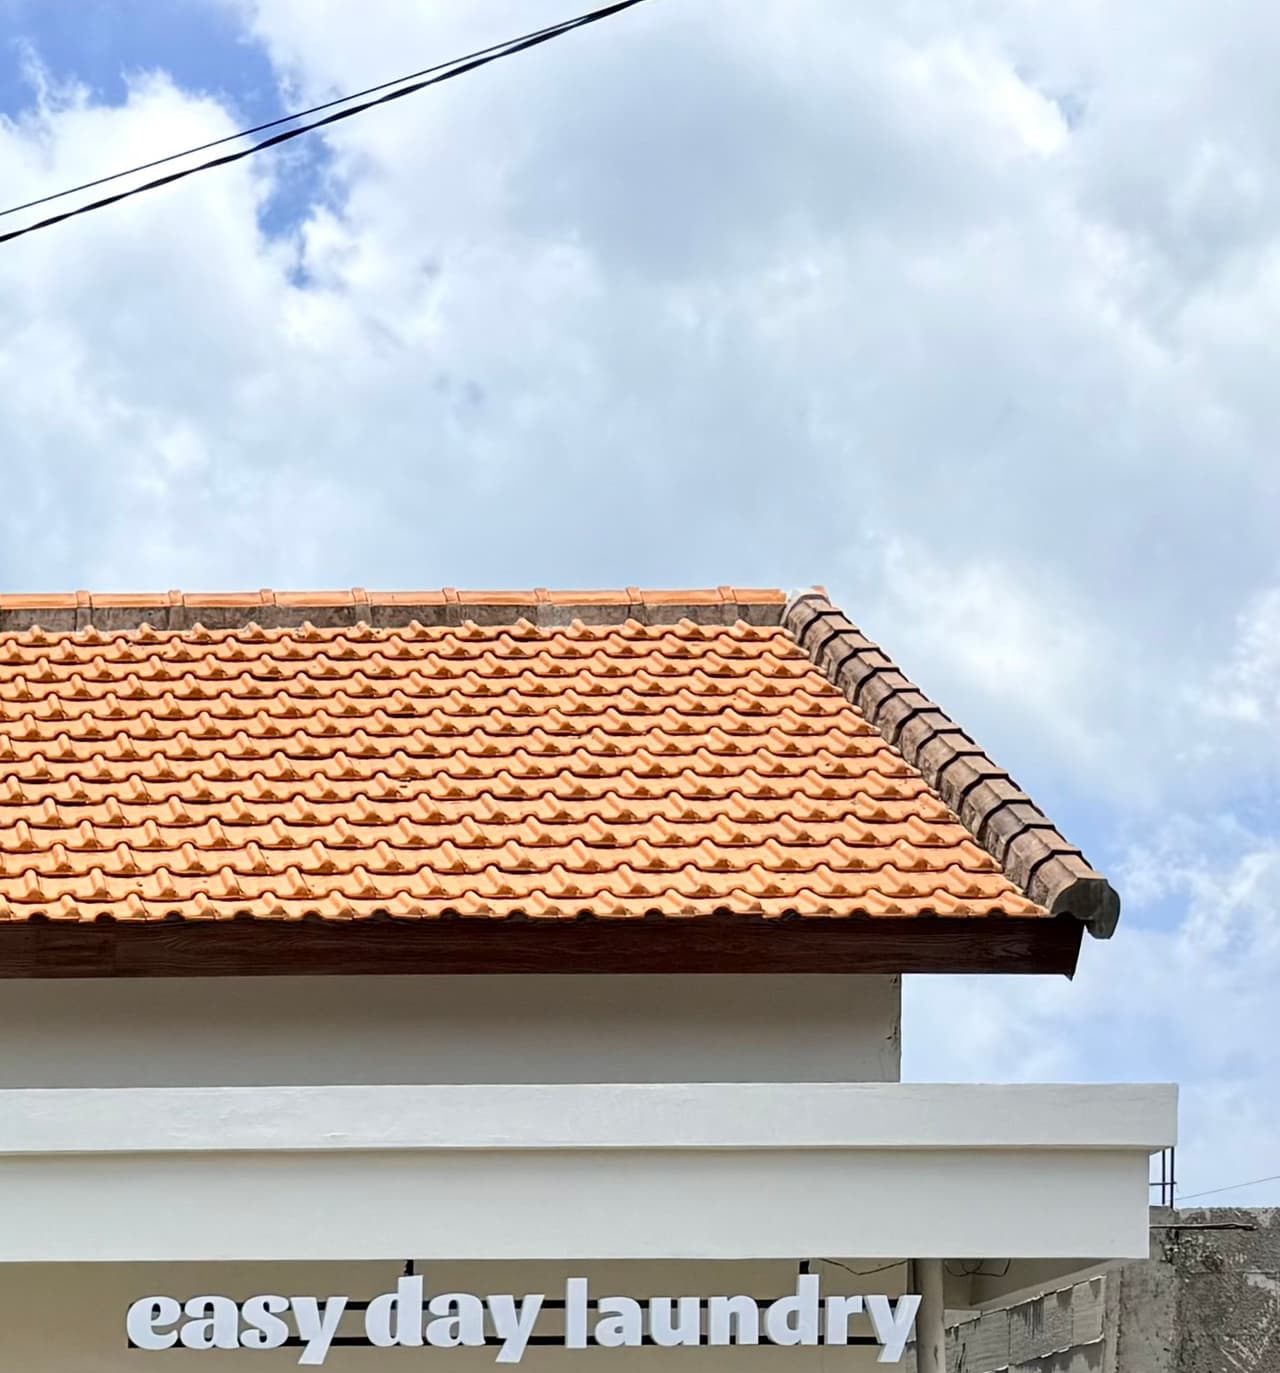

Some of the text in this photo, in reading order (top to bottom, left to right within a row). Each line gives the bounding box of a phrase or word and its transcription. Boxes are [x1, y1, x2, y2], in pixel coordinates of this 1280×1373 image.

[125, 1273, 924, 1365] easy day laundry
